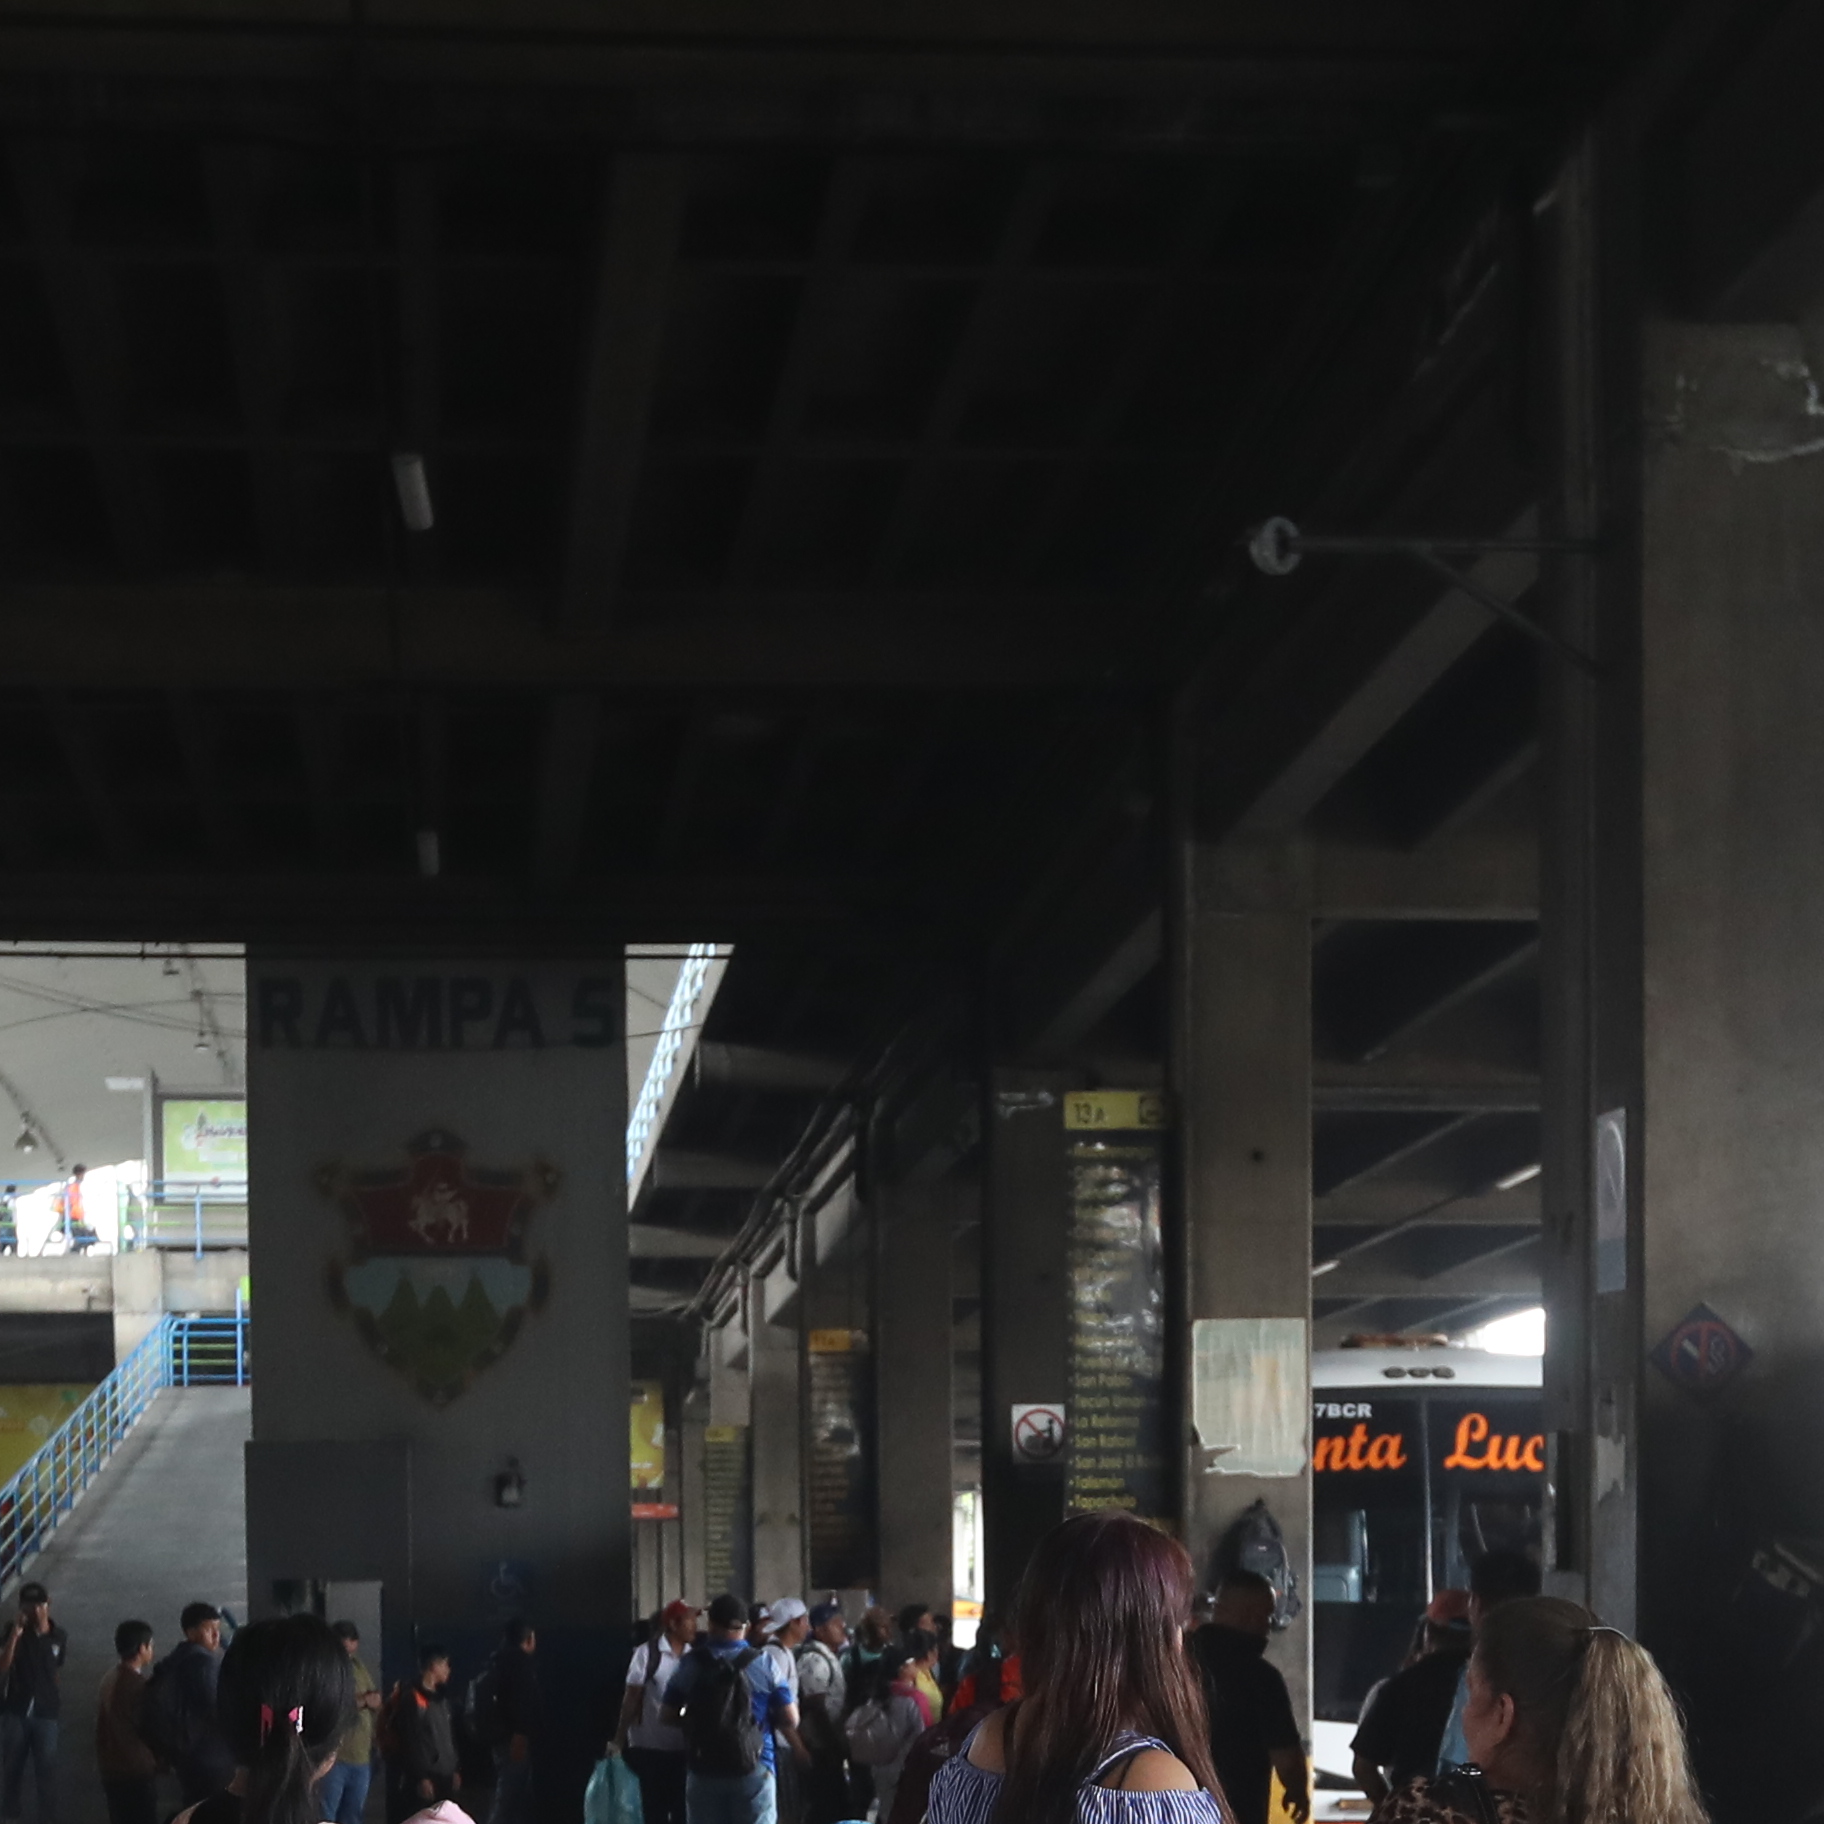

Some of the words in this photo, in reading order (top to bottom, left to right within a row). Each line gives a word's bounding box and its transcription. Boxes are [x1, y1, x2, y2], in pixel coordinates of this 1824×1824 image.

[256, 975, 546, 1048] RAMPA
[1313, 1421, 1409, 1473] nta
[1442, 1411, 1546, 1474] Luc
